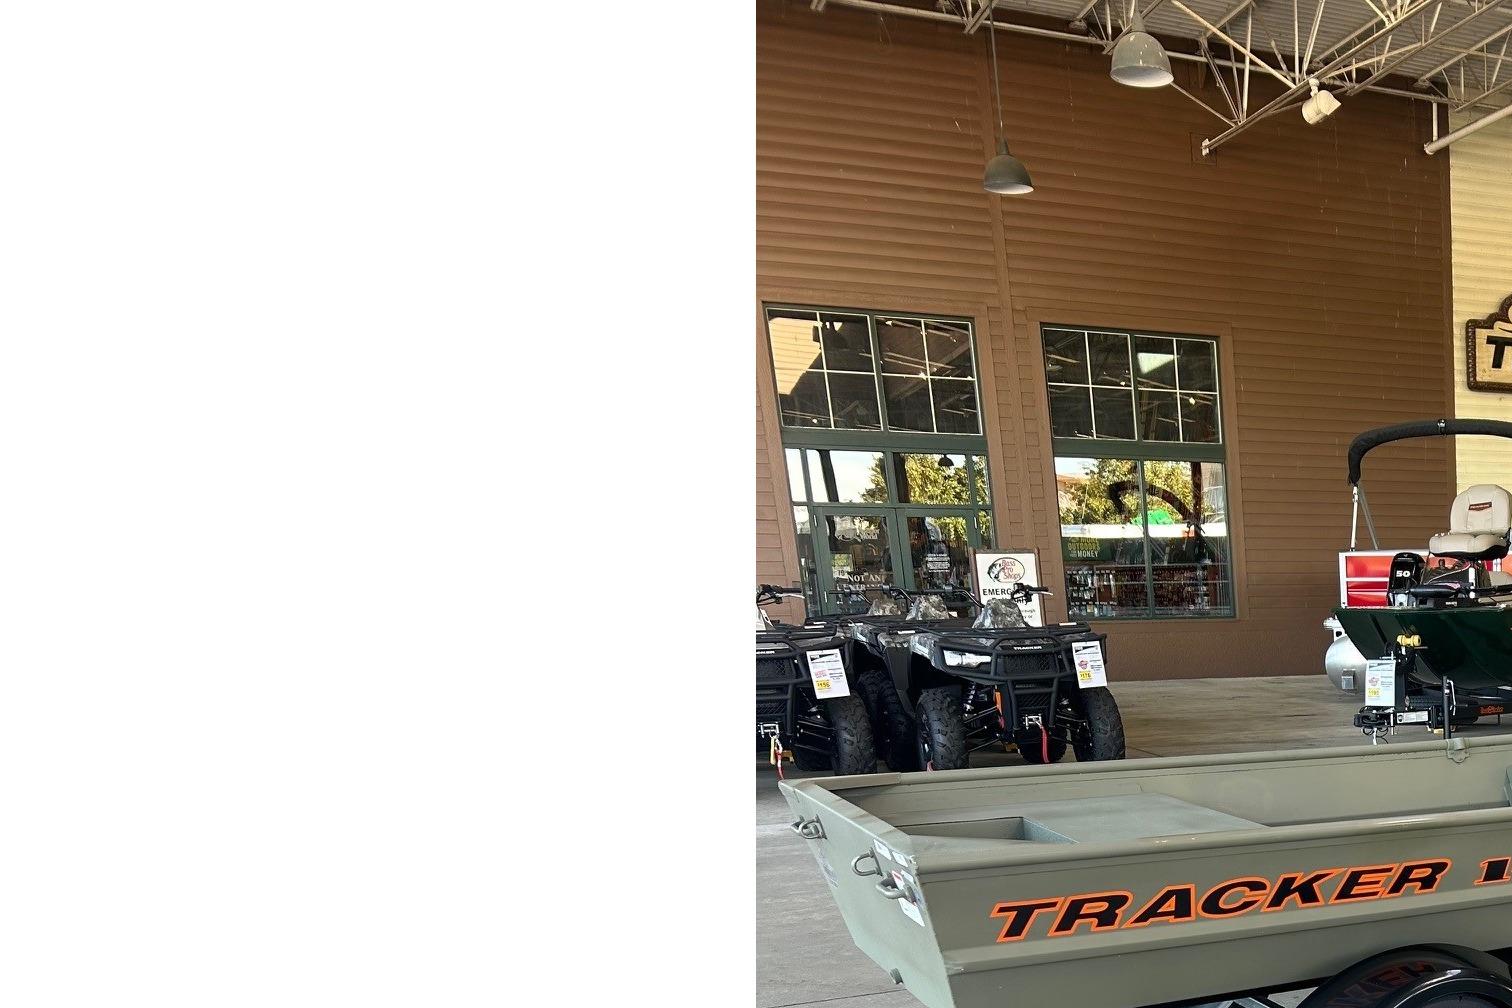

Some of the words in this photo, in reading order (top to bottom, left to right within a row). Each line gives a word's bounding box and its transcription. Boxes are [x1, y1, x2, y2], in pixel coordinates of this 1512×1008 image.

[847, 574, 865, 582] NOT
[868, 574, 881, 582] AN
[1396, 570, 1411, 578] 50
[982, 588, 1014, 596] EMERG
[990, 857, 1453, 943] TRACKER
